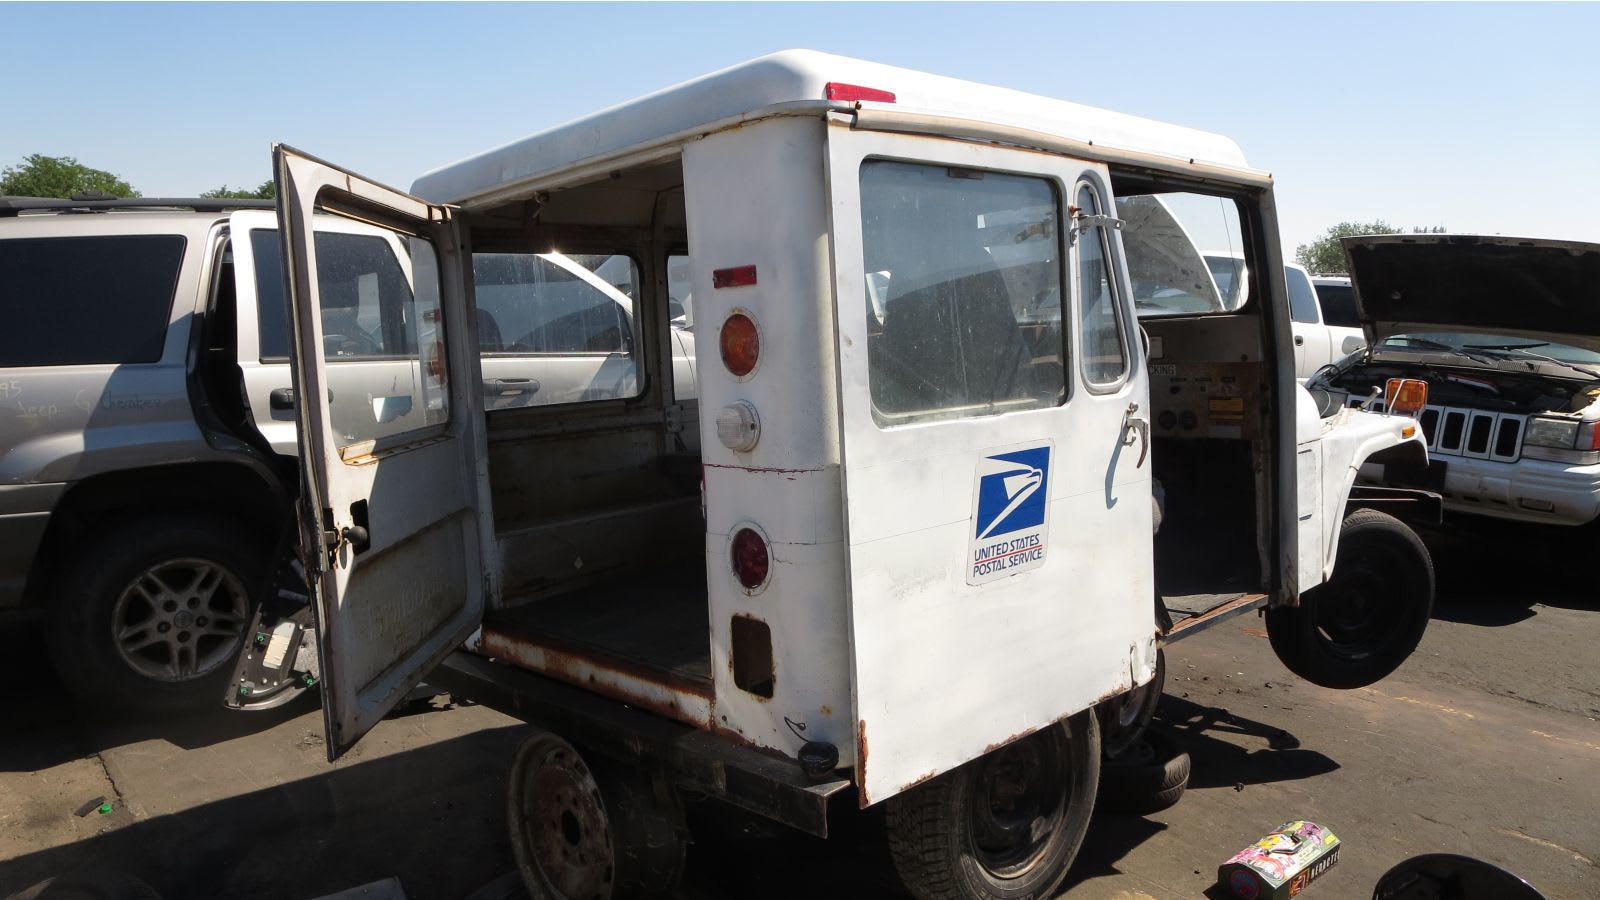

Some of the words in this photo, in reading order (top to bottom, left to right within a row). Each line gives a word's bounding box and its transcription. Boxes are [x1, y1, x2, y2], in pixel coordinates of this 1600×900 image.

[973, 558, 1007, 578] POSTAL
[1008, 547, 1043, 568] SERVICE
[974, 542, 1008, 562] UNITED
[1009, 533, 1040, 552] STATES
